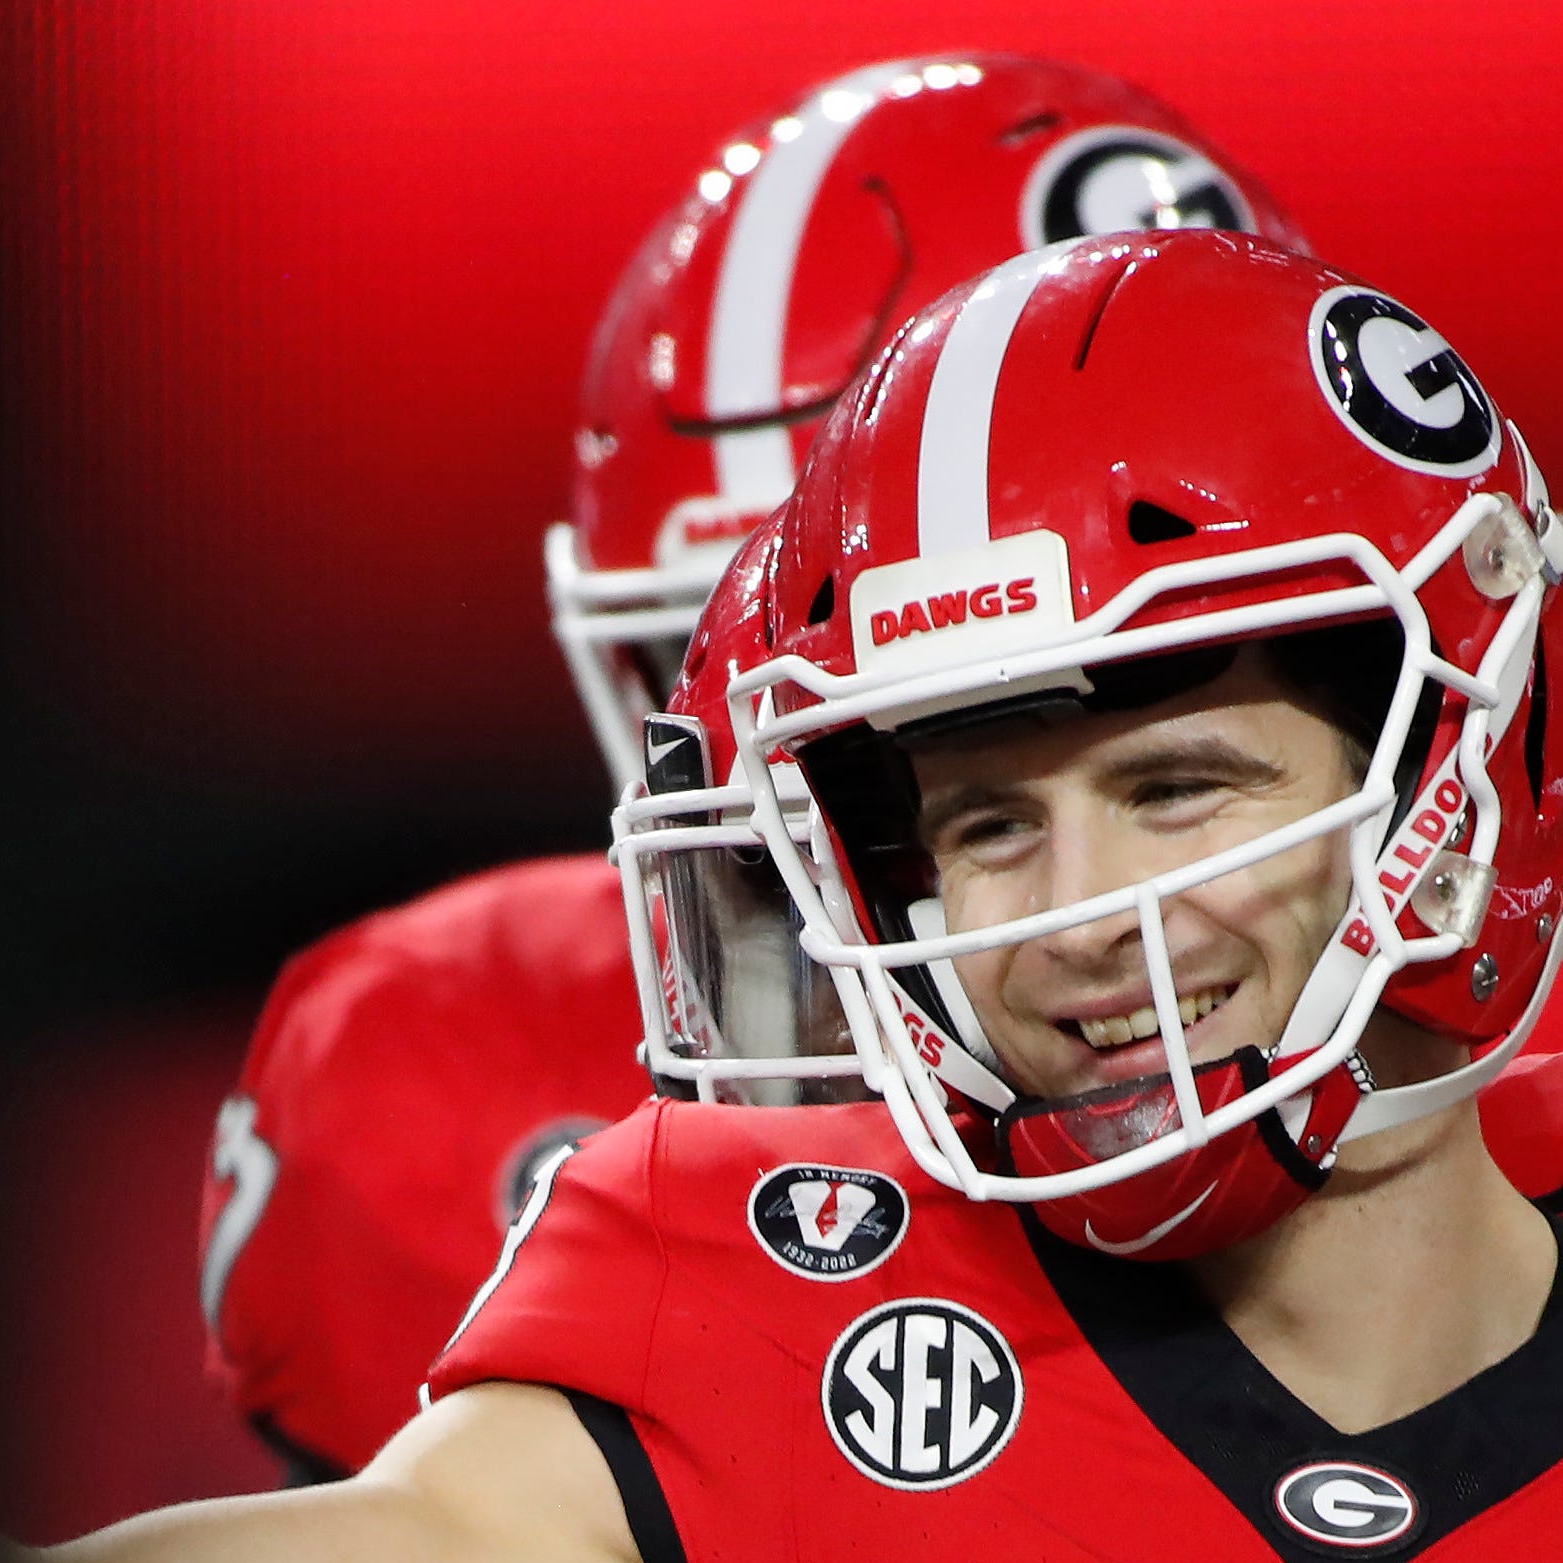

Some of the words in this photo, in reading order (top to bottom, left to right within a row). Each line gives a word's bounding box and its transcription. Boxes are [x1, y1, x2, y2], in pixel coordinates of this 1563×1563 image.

[870, 577, 1037, 647] DAWGS
[1341, 733, 1492, 957] BLLDO
[842, 1314, 1000, 1475] SEC
[1284, 1469, 1412, 1540] G
